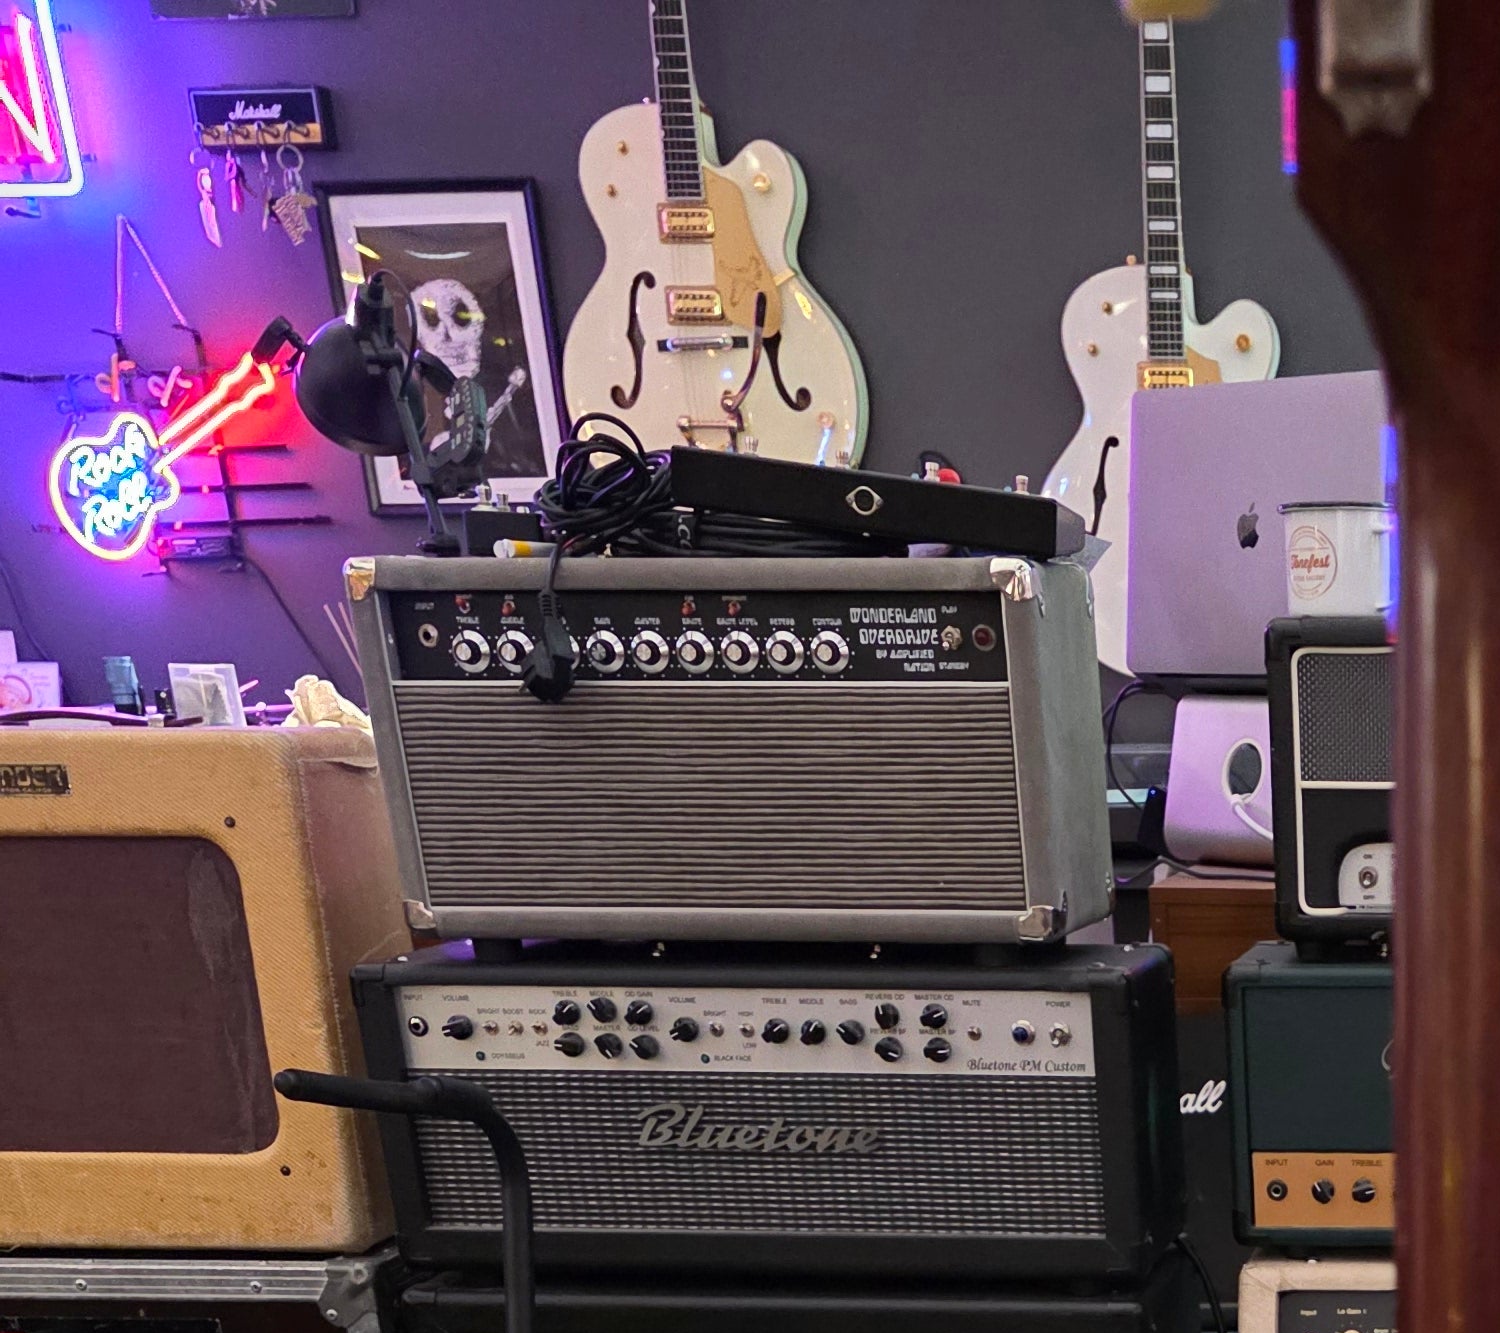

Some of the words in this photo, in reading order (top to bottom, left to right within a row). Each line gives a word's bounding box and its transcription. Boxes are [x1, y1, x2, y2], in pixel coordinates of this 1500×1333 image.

[850, 607, 937, 624] WONDERLAND
[859, 628, 939, 645] OVERDRIVE
[967, 1058, 1017, 1071] Bluetone
[1019, 1060, 1041, 1072] PM
[1045, 1060, 1086, 1073] Custom
[637, 1103, 878, 1152] Bluetone
[1315, 1159, 1334, 1167] GAIN
[1351, 1159, 1383, 1167] TREBLE
